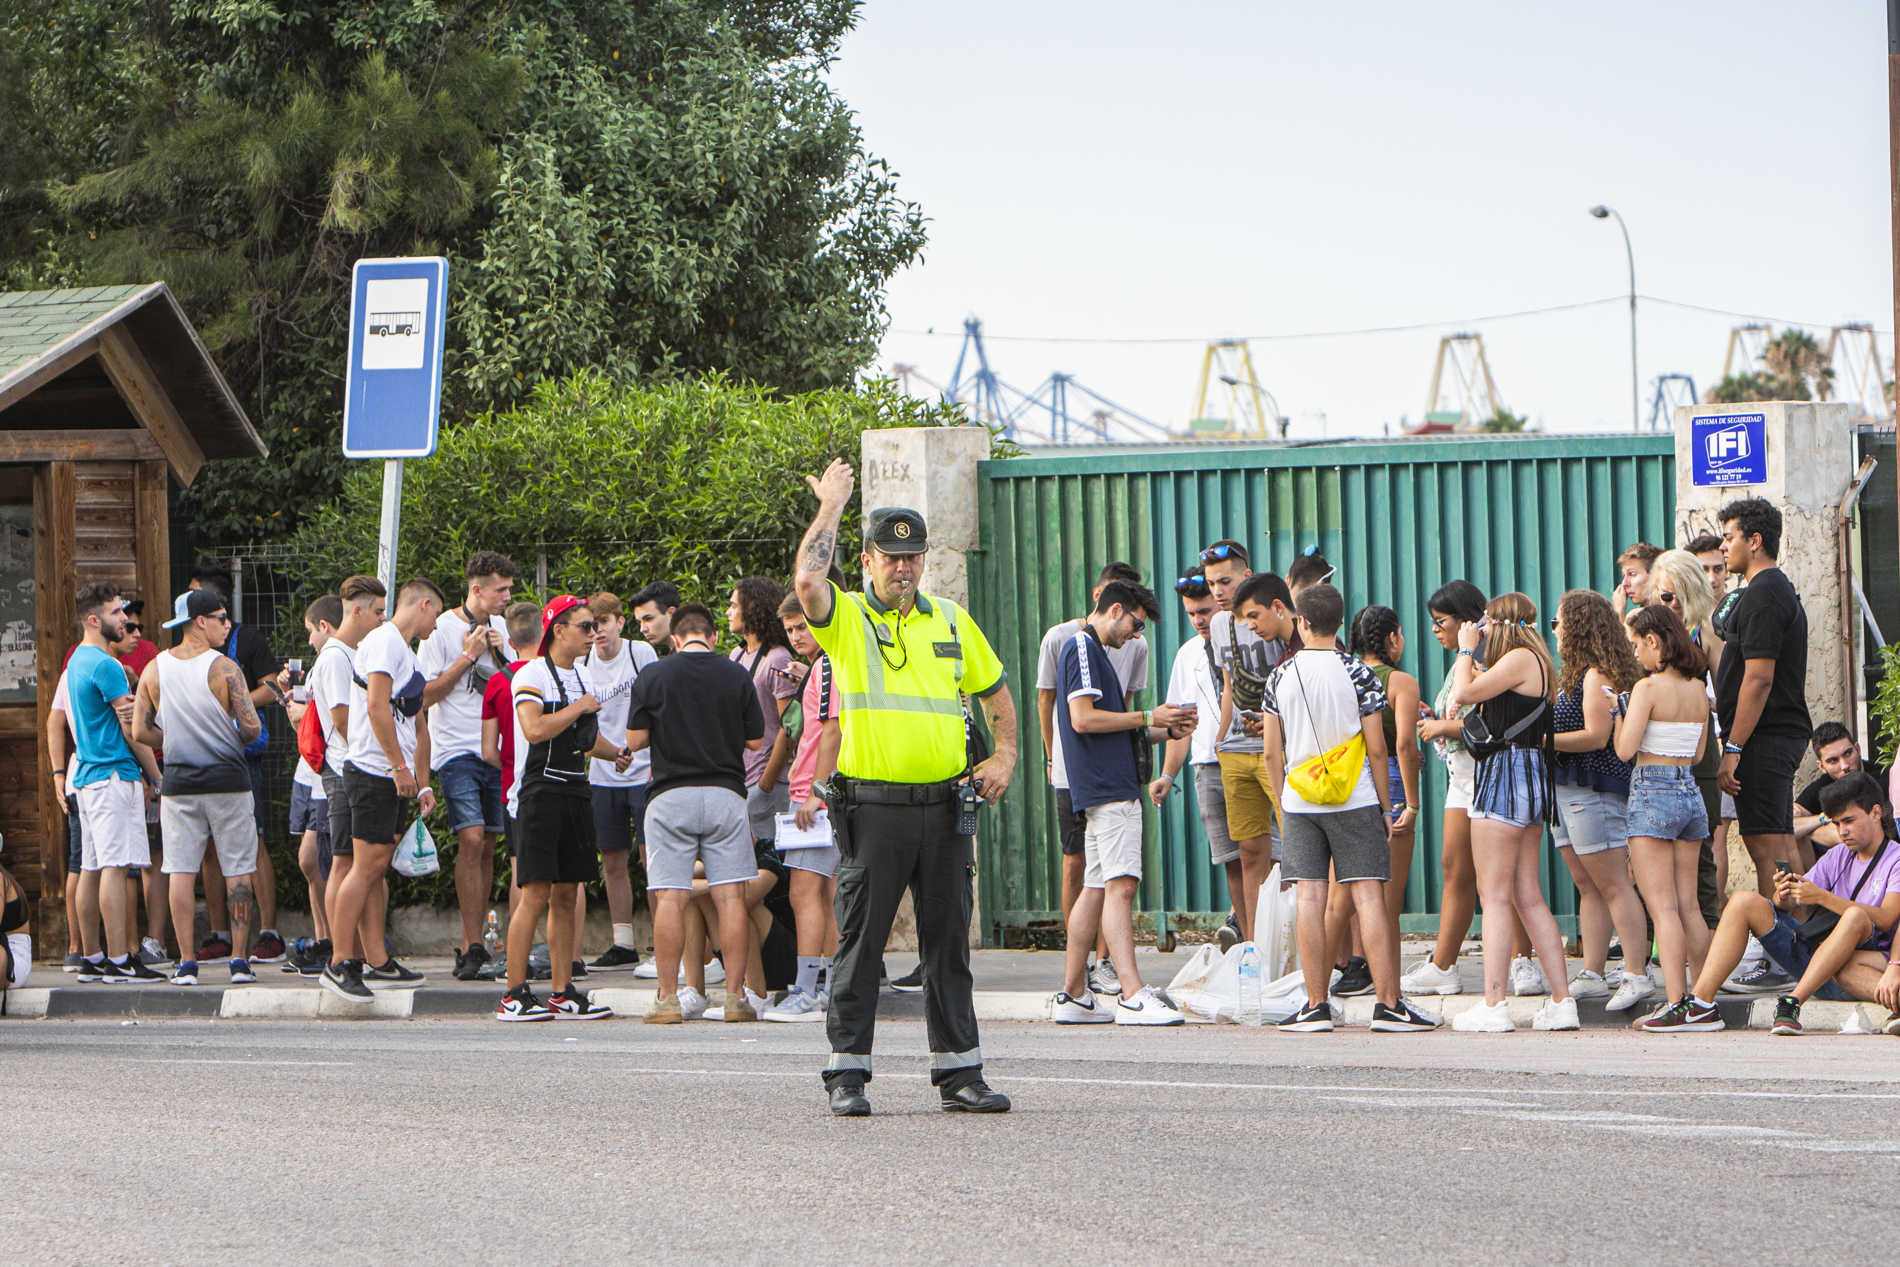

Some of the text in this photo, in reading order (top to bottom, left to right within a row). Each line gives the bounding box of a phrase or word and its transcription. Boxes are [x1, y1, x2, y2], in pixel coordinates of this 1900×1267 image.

[1695, 415, 1762, 426] SISTEMA DE SEGURIDAD
[1709, 431, 1747, 458] IFI
